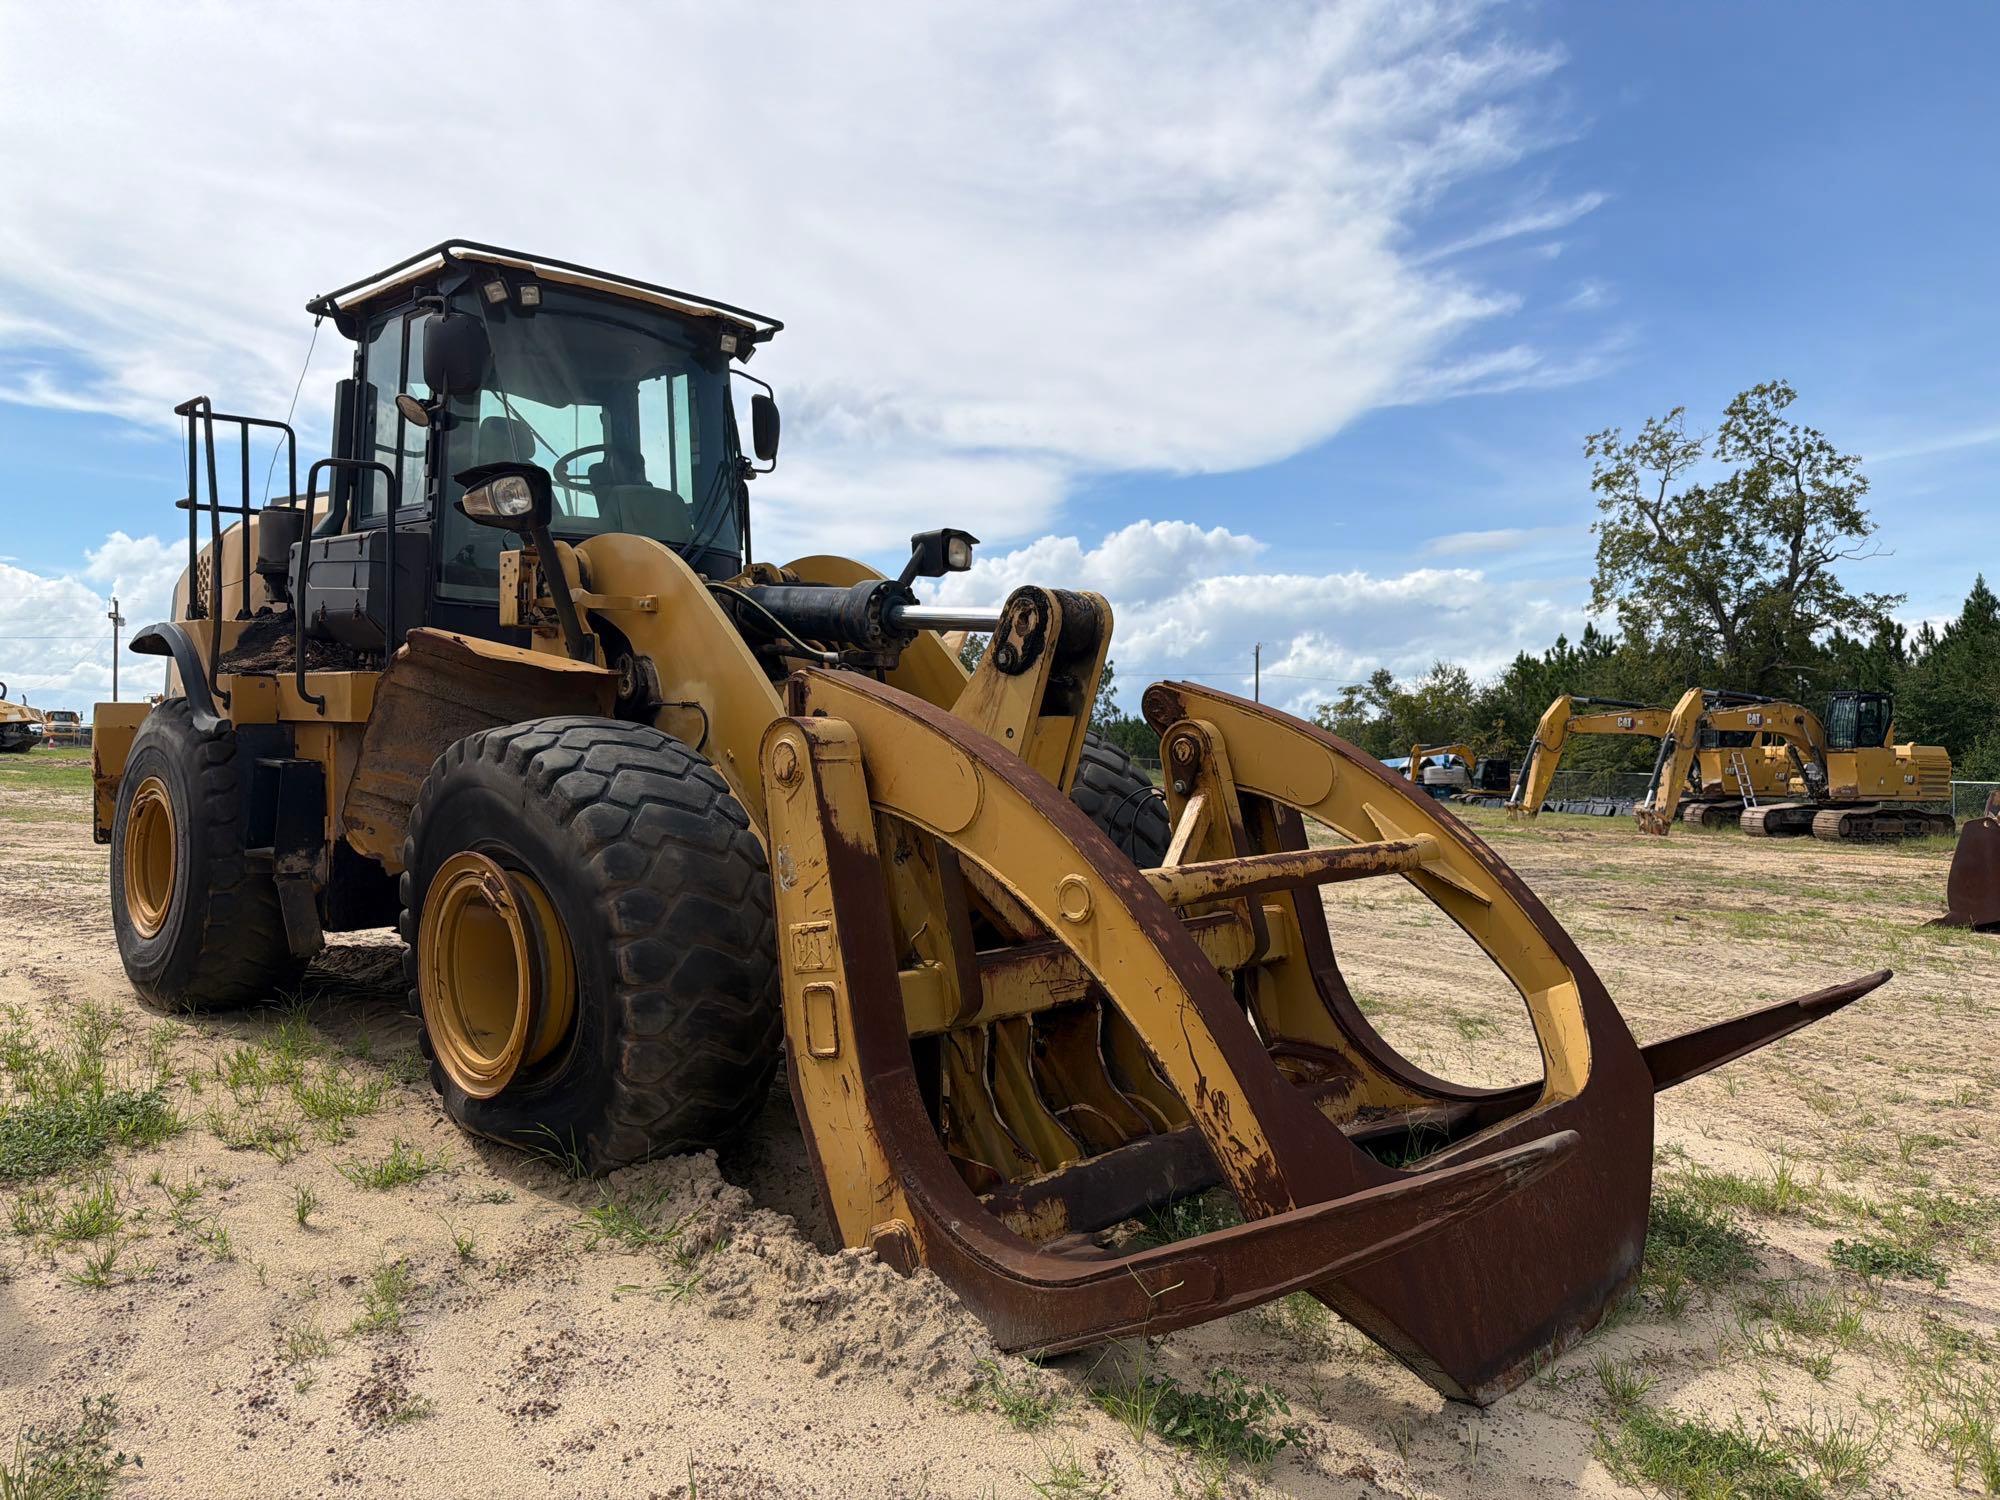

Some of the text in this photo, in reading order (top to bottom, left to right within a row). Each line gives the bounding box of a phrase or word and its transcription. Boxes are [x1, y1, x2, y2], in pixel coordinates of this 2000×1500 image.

[1617, 716, 1633, 728] CAT
[1746, 713, 1761, 725] CAT
[1903, 774, 1914, 783] CAT
